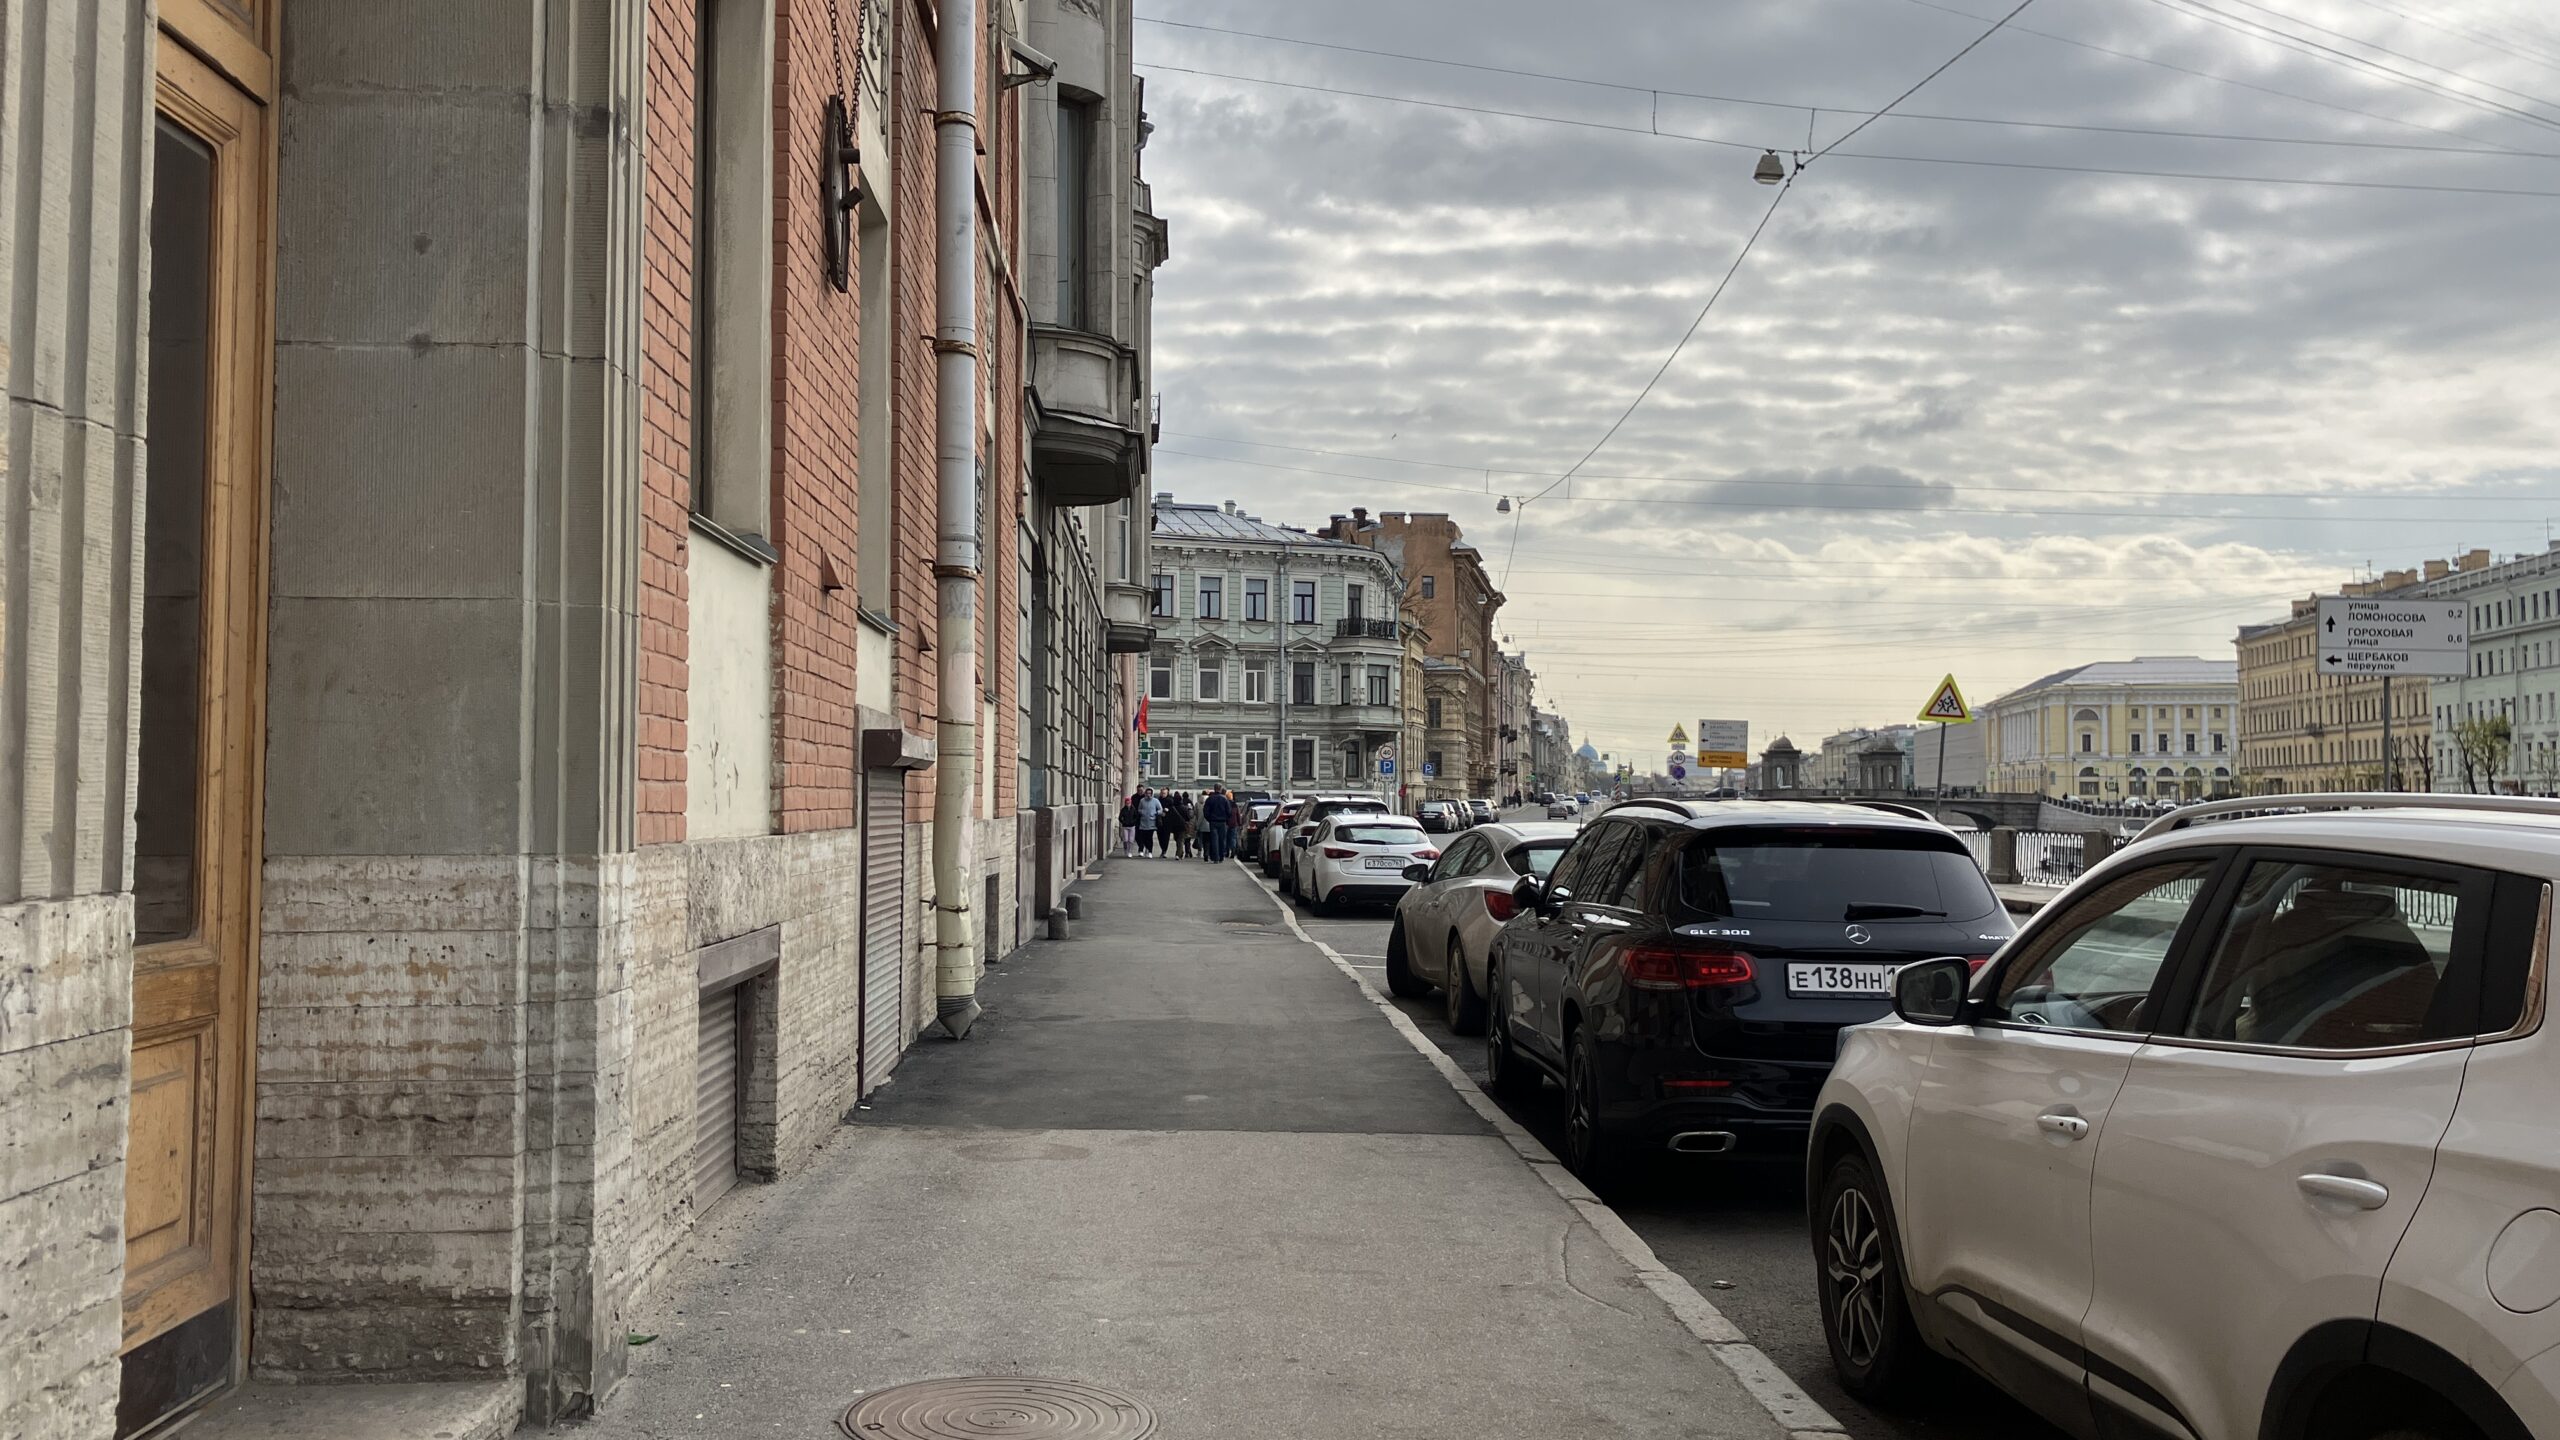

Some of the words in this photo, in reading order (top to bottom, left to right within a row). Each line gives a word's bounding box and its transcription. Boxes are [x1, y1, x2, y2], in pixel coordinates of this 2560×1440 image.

[2348, 602, 2379, 611] улица
[2348, 612, 2427, 623] ЛОМОНОСОВА
[2448, 609, 2463, 620] 0,2
[2347, 627, 2413, 638] ГОРОХОВАЯ
[2347, 638, 2379, 646] улица
[2347, 652, 2409, 663] ЩЕРБАКОВ
[2347, 662, 2395, 672] переулок
